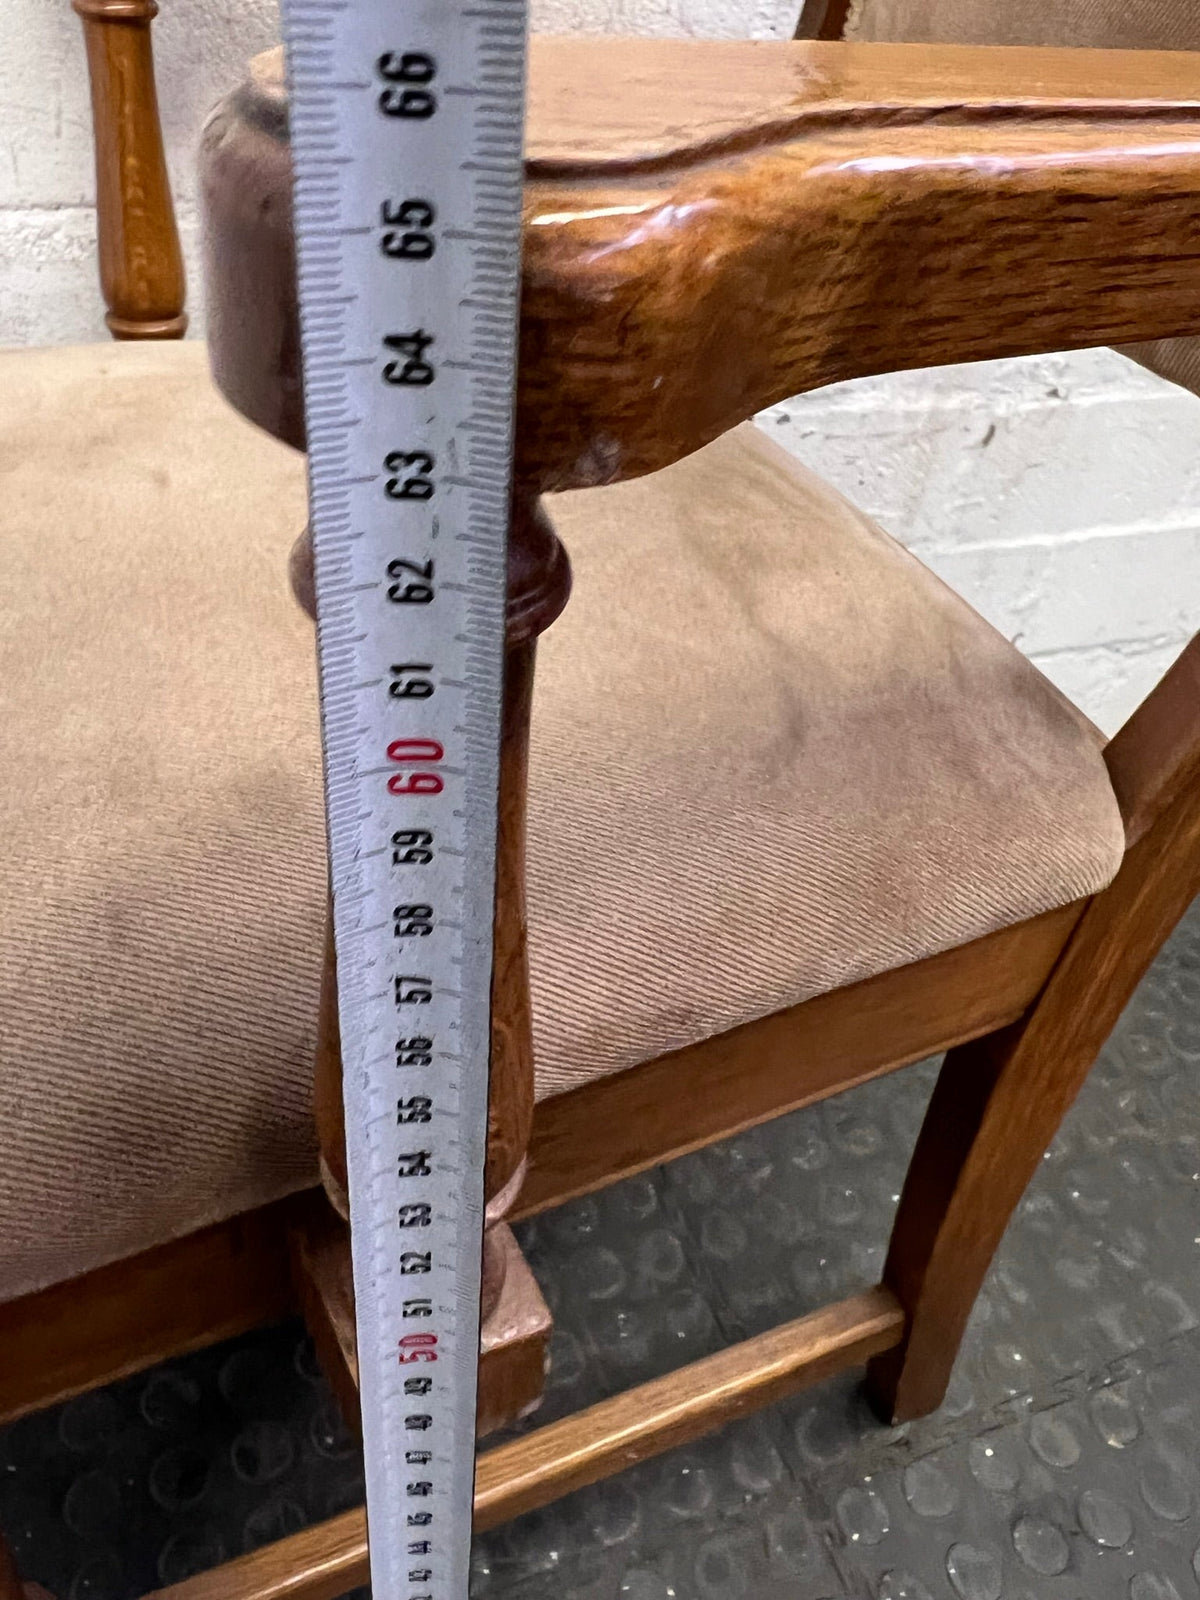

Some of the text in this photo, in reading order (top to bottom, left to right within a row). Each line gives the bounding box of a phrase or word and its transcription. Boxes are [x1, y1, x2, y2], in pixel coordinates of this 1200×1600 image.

[376, 51, 437, 120] 66
[379, 198, 435, 261] 65
[382, 328, 435, 387] 64
[384, 450, 436, 501] 63
[387, 558, 435, 604] 62
[389, 663, 435, 700] 61
[386, 738, 444, 796] 60
[391, 828, 434, 866] 59
[393, 903, 434, 937] 58
[394, 974, 432, 1011] 57
[396, 1035, 433, 1068] 56
[397, 1096, 433, 1125] 55
[398, 1150, 432, 1178] 54
[398, 1203, 431, 1229] 53
[400, 1251, 431, 1275] 52
[402, 1299, 432, 1318] 51
[398, 1333, 438, 1365] 50
